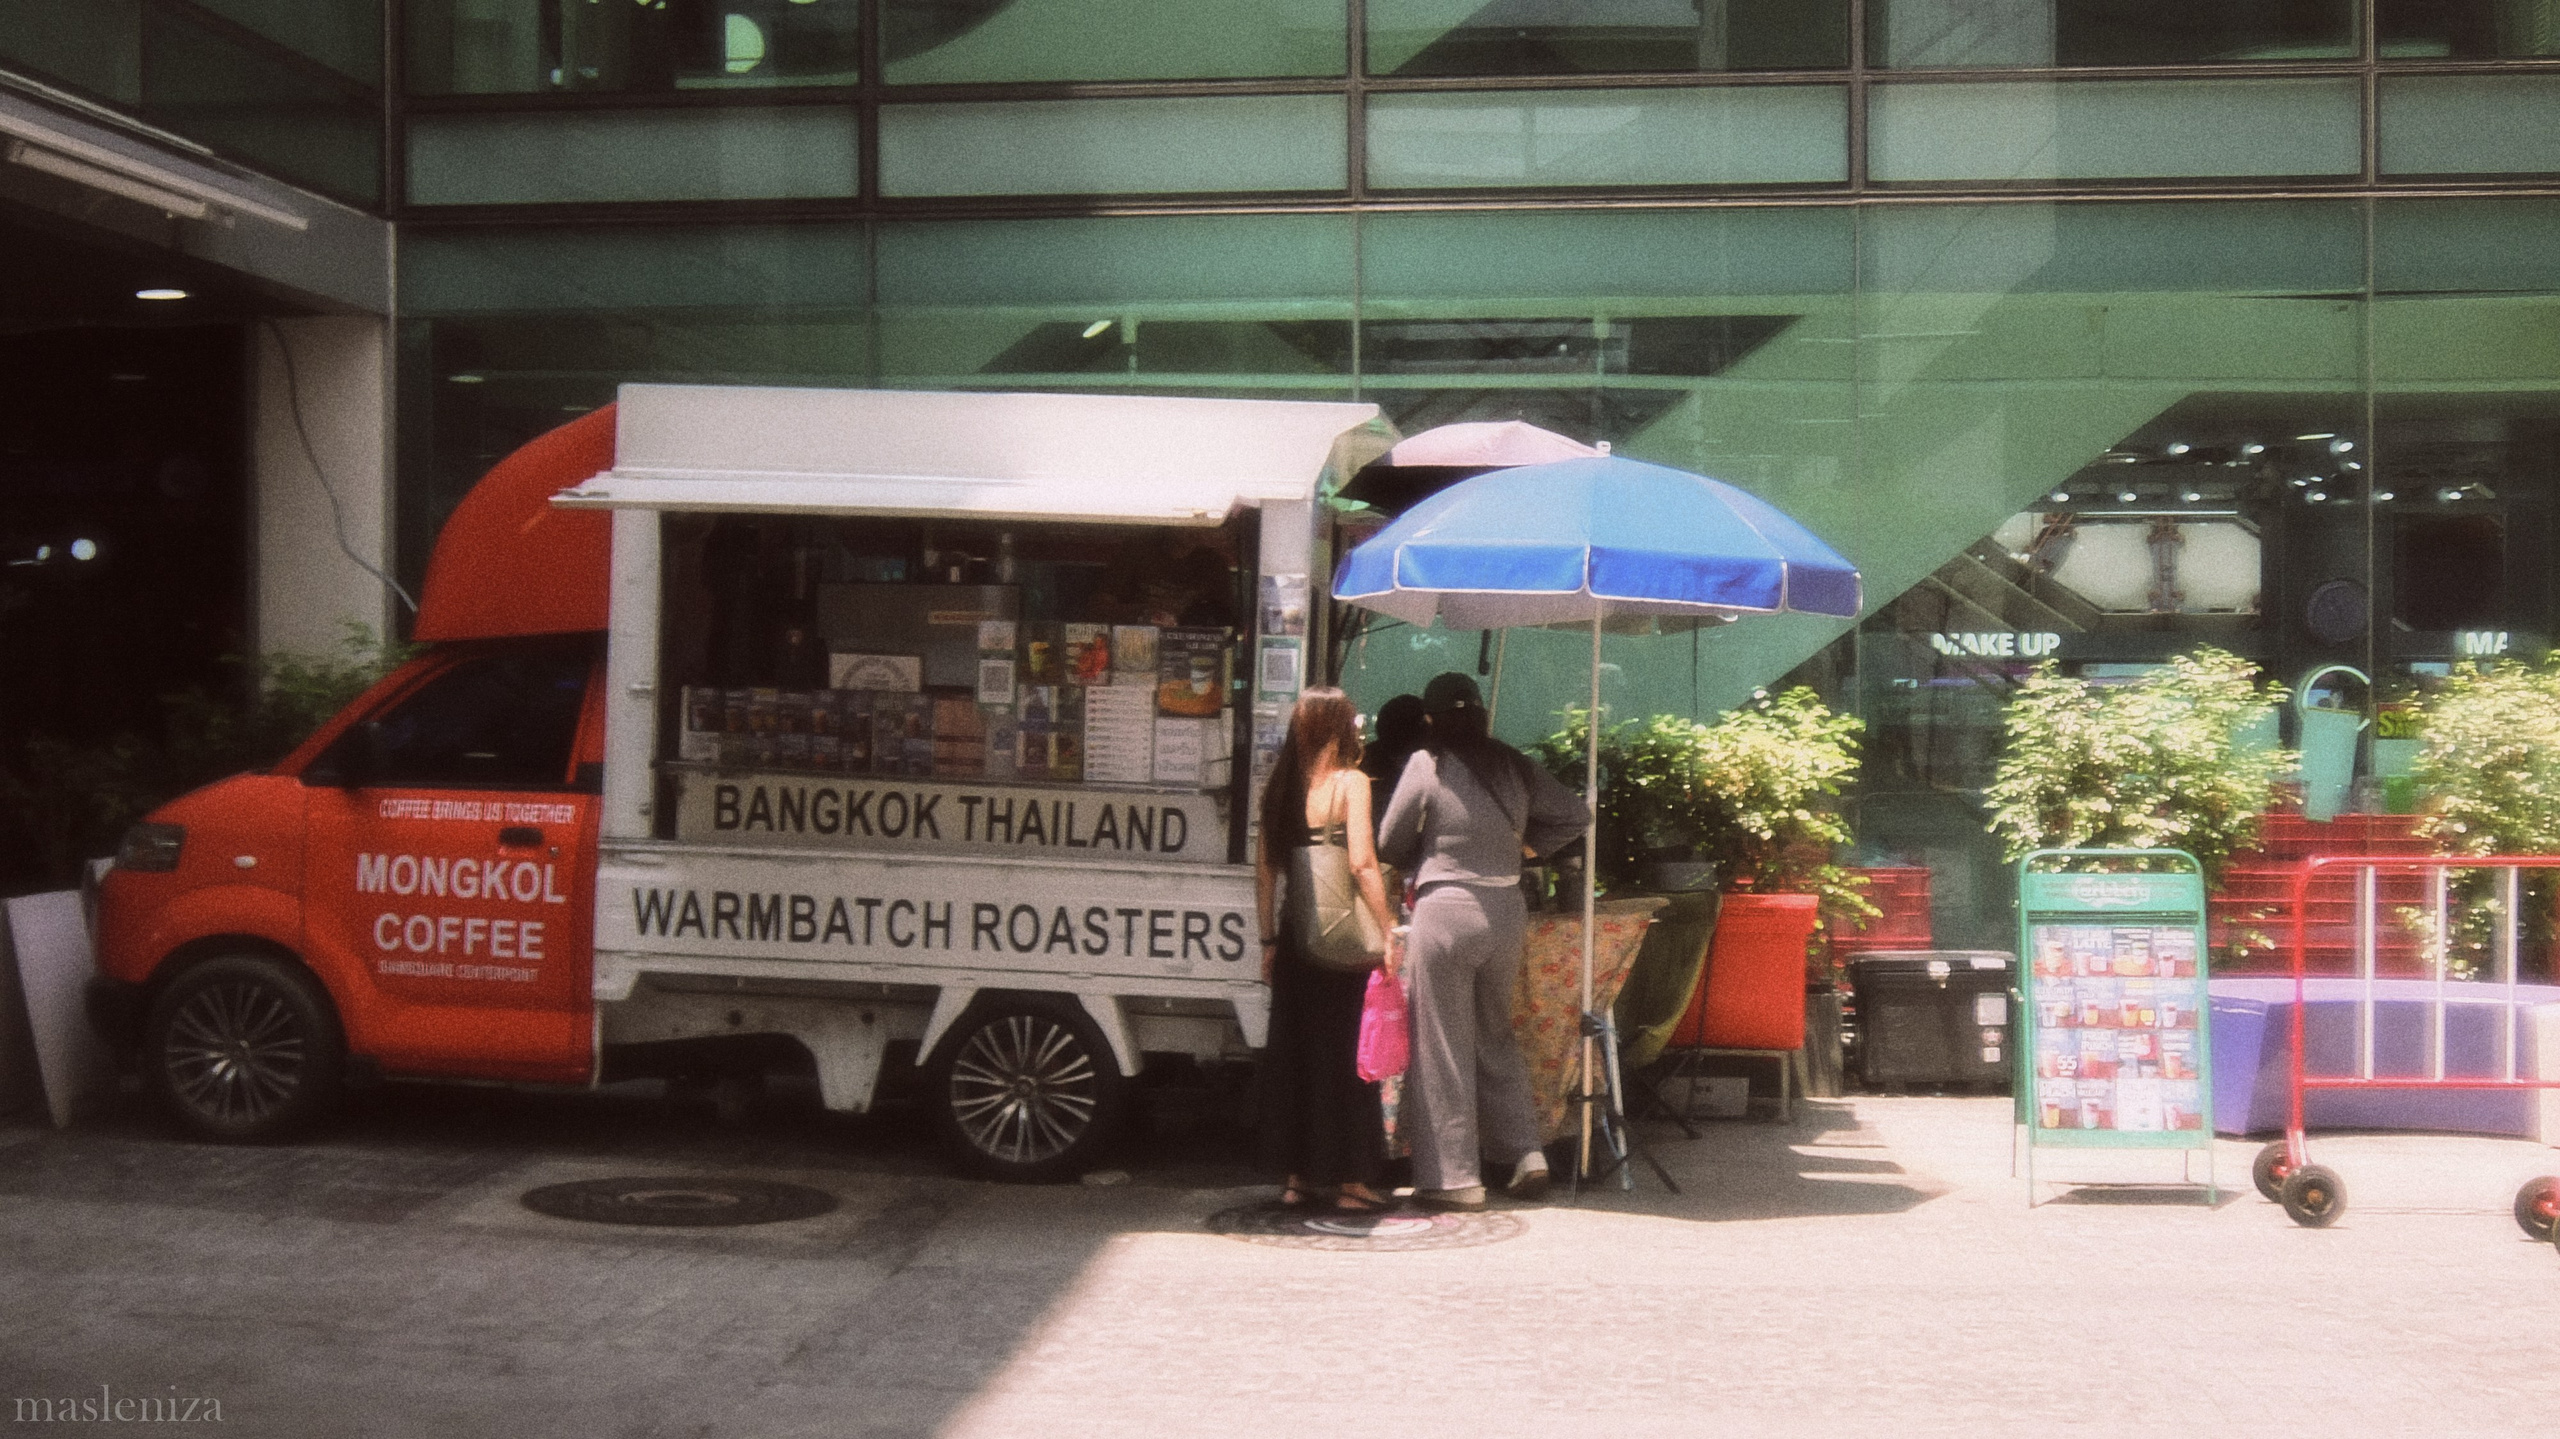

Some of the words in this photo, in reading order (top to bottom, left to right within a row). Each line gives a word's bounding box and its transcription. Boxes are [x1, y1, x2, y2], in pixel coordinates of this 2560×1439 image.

[2020, 632, 2061, 656] UP
[379, 798, 431, 819] COFFEE
[432, 800, 482, 821] BRINGS
[483, 801, 503, 821] US
[504, 802, 576, 824] TOGETHER
[713, 784, 942, 842] BANGKOK
[958, 795, 1189, 854] THAILAND
[356, 852, 566, 904] MONGKOL
[373, 912, 546, 960] COFFEE
[632, 887, 953, 951] WARMBATCH
[970, 903, 1247, 963] ROASTERS
